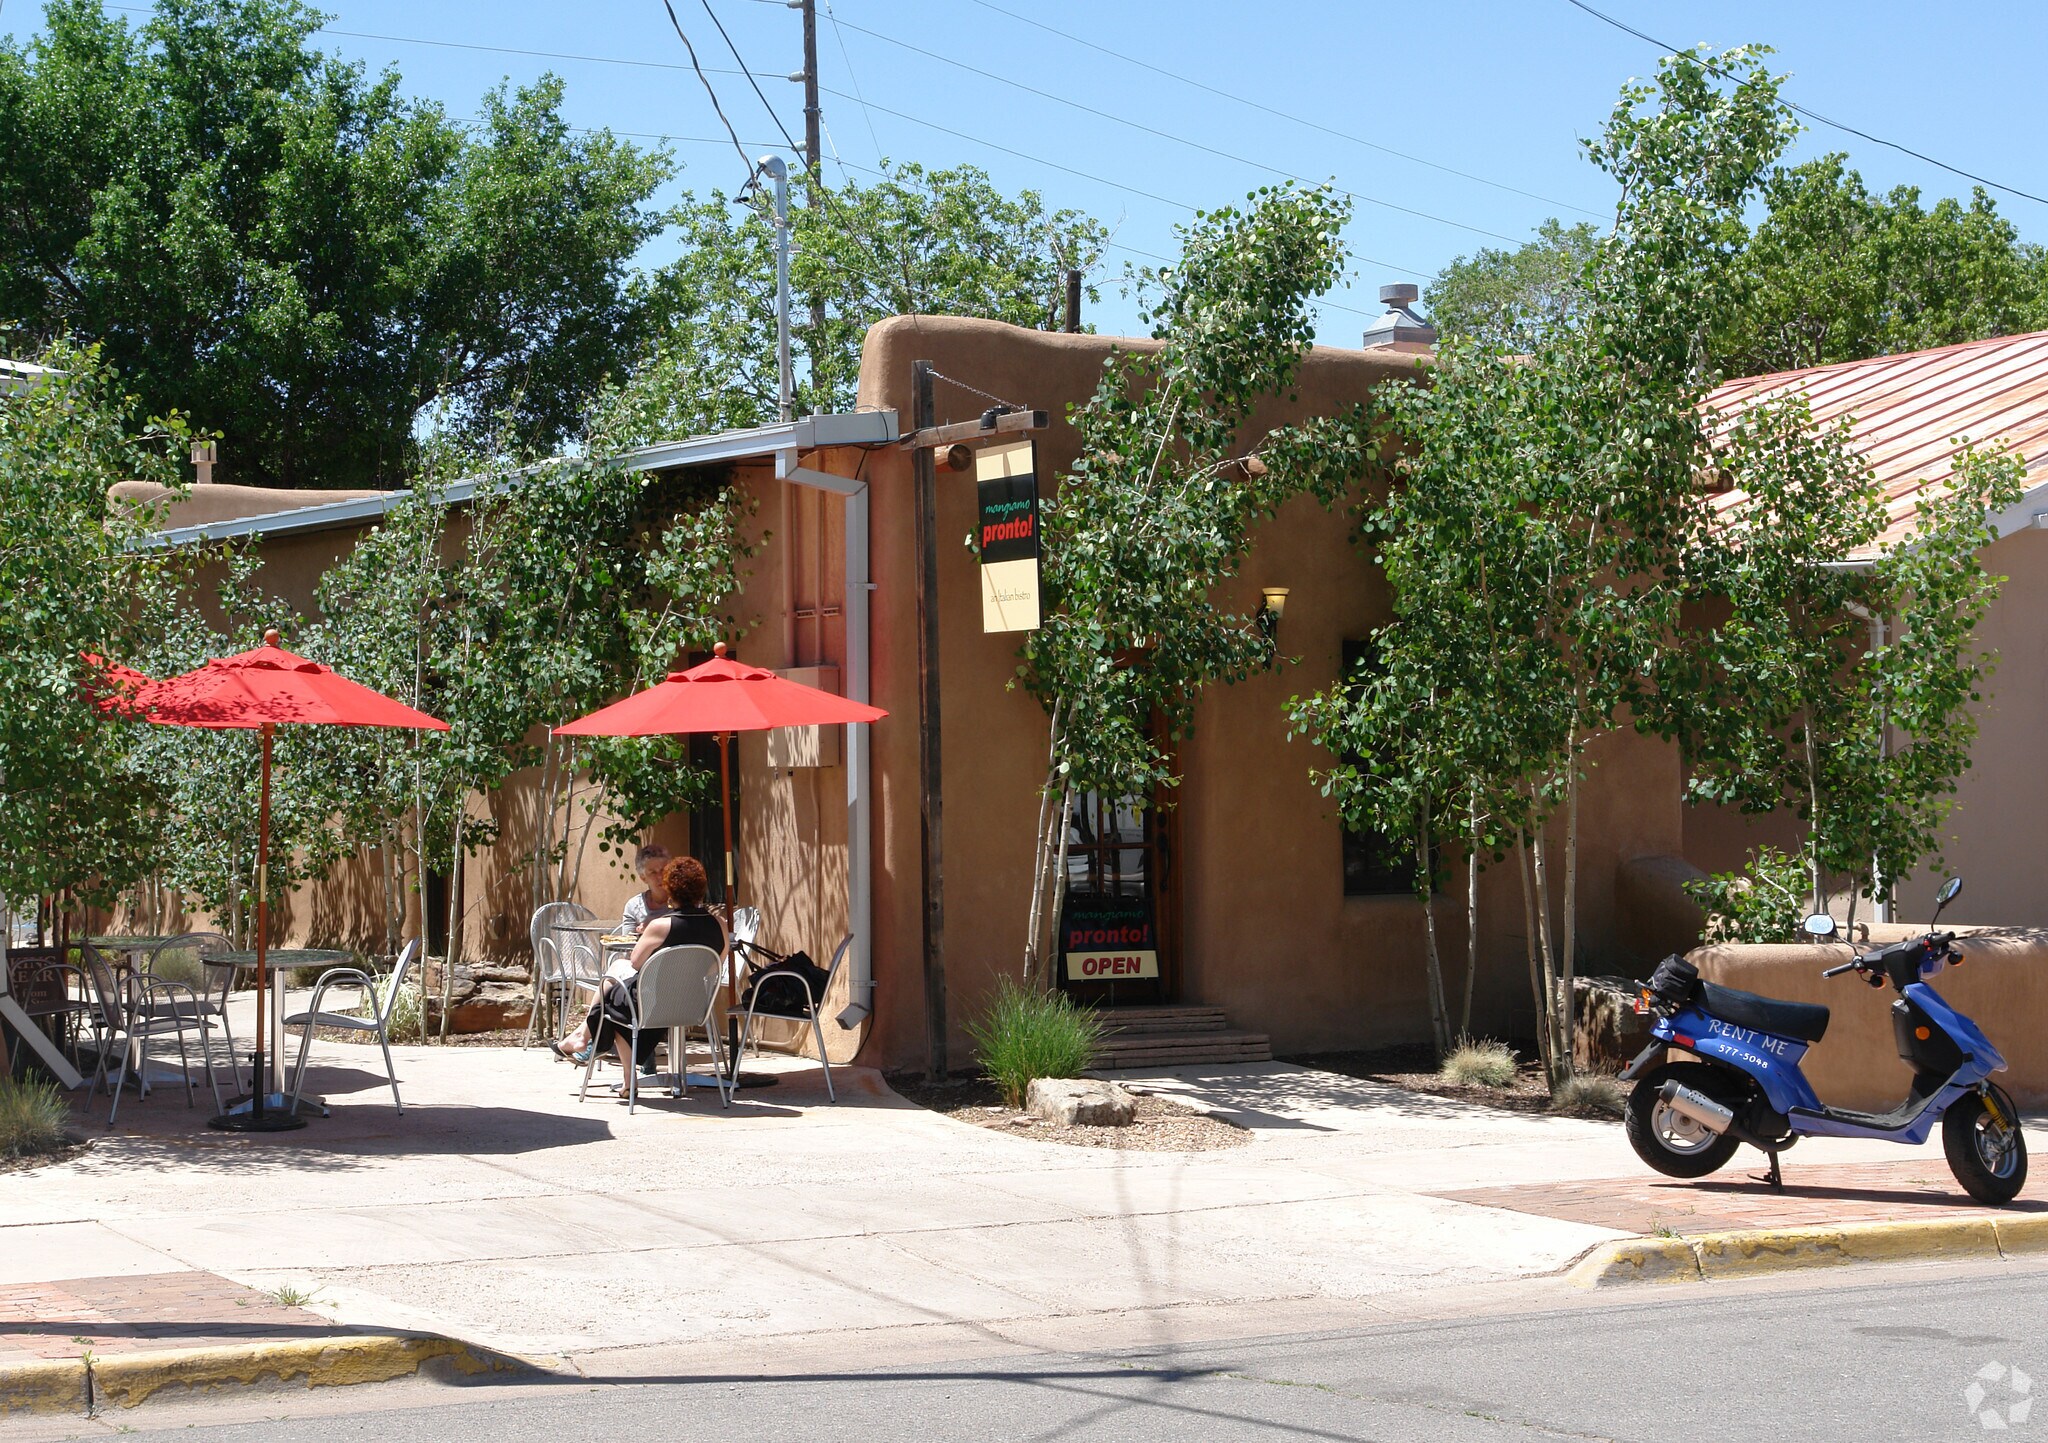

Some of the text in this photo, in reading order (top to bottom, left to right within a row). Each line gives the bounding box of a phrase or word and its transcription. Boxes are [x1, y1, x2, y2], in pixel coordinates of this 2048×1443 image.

[985, 498, 1031, 521] mangiamo
[982, 513, 1033, 548] pronto!
[990, 594, 998, 603] an
[1014, 587, 1031, 601] bistro
[1073, 910, 1144, 922] mangiamo
[1069, 924, 1149, 949] pronto!
[1082, 957, 1142, 976] OPEN
[1708, 1019, 1789, 1056] RENT ME
[1718, 1044, 1769, 1069] 577-5048
